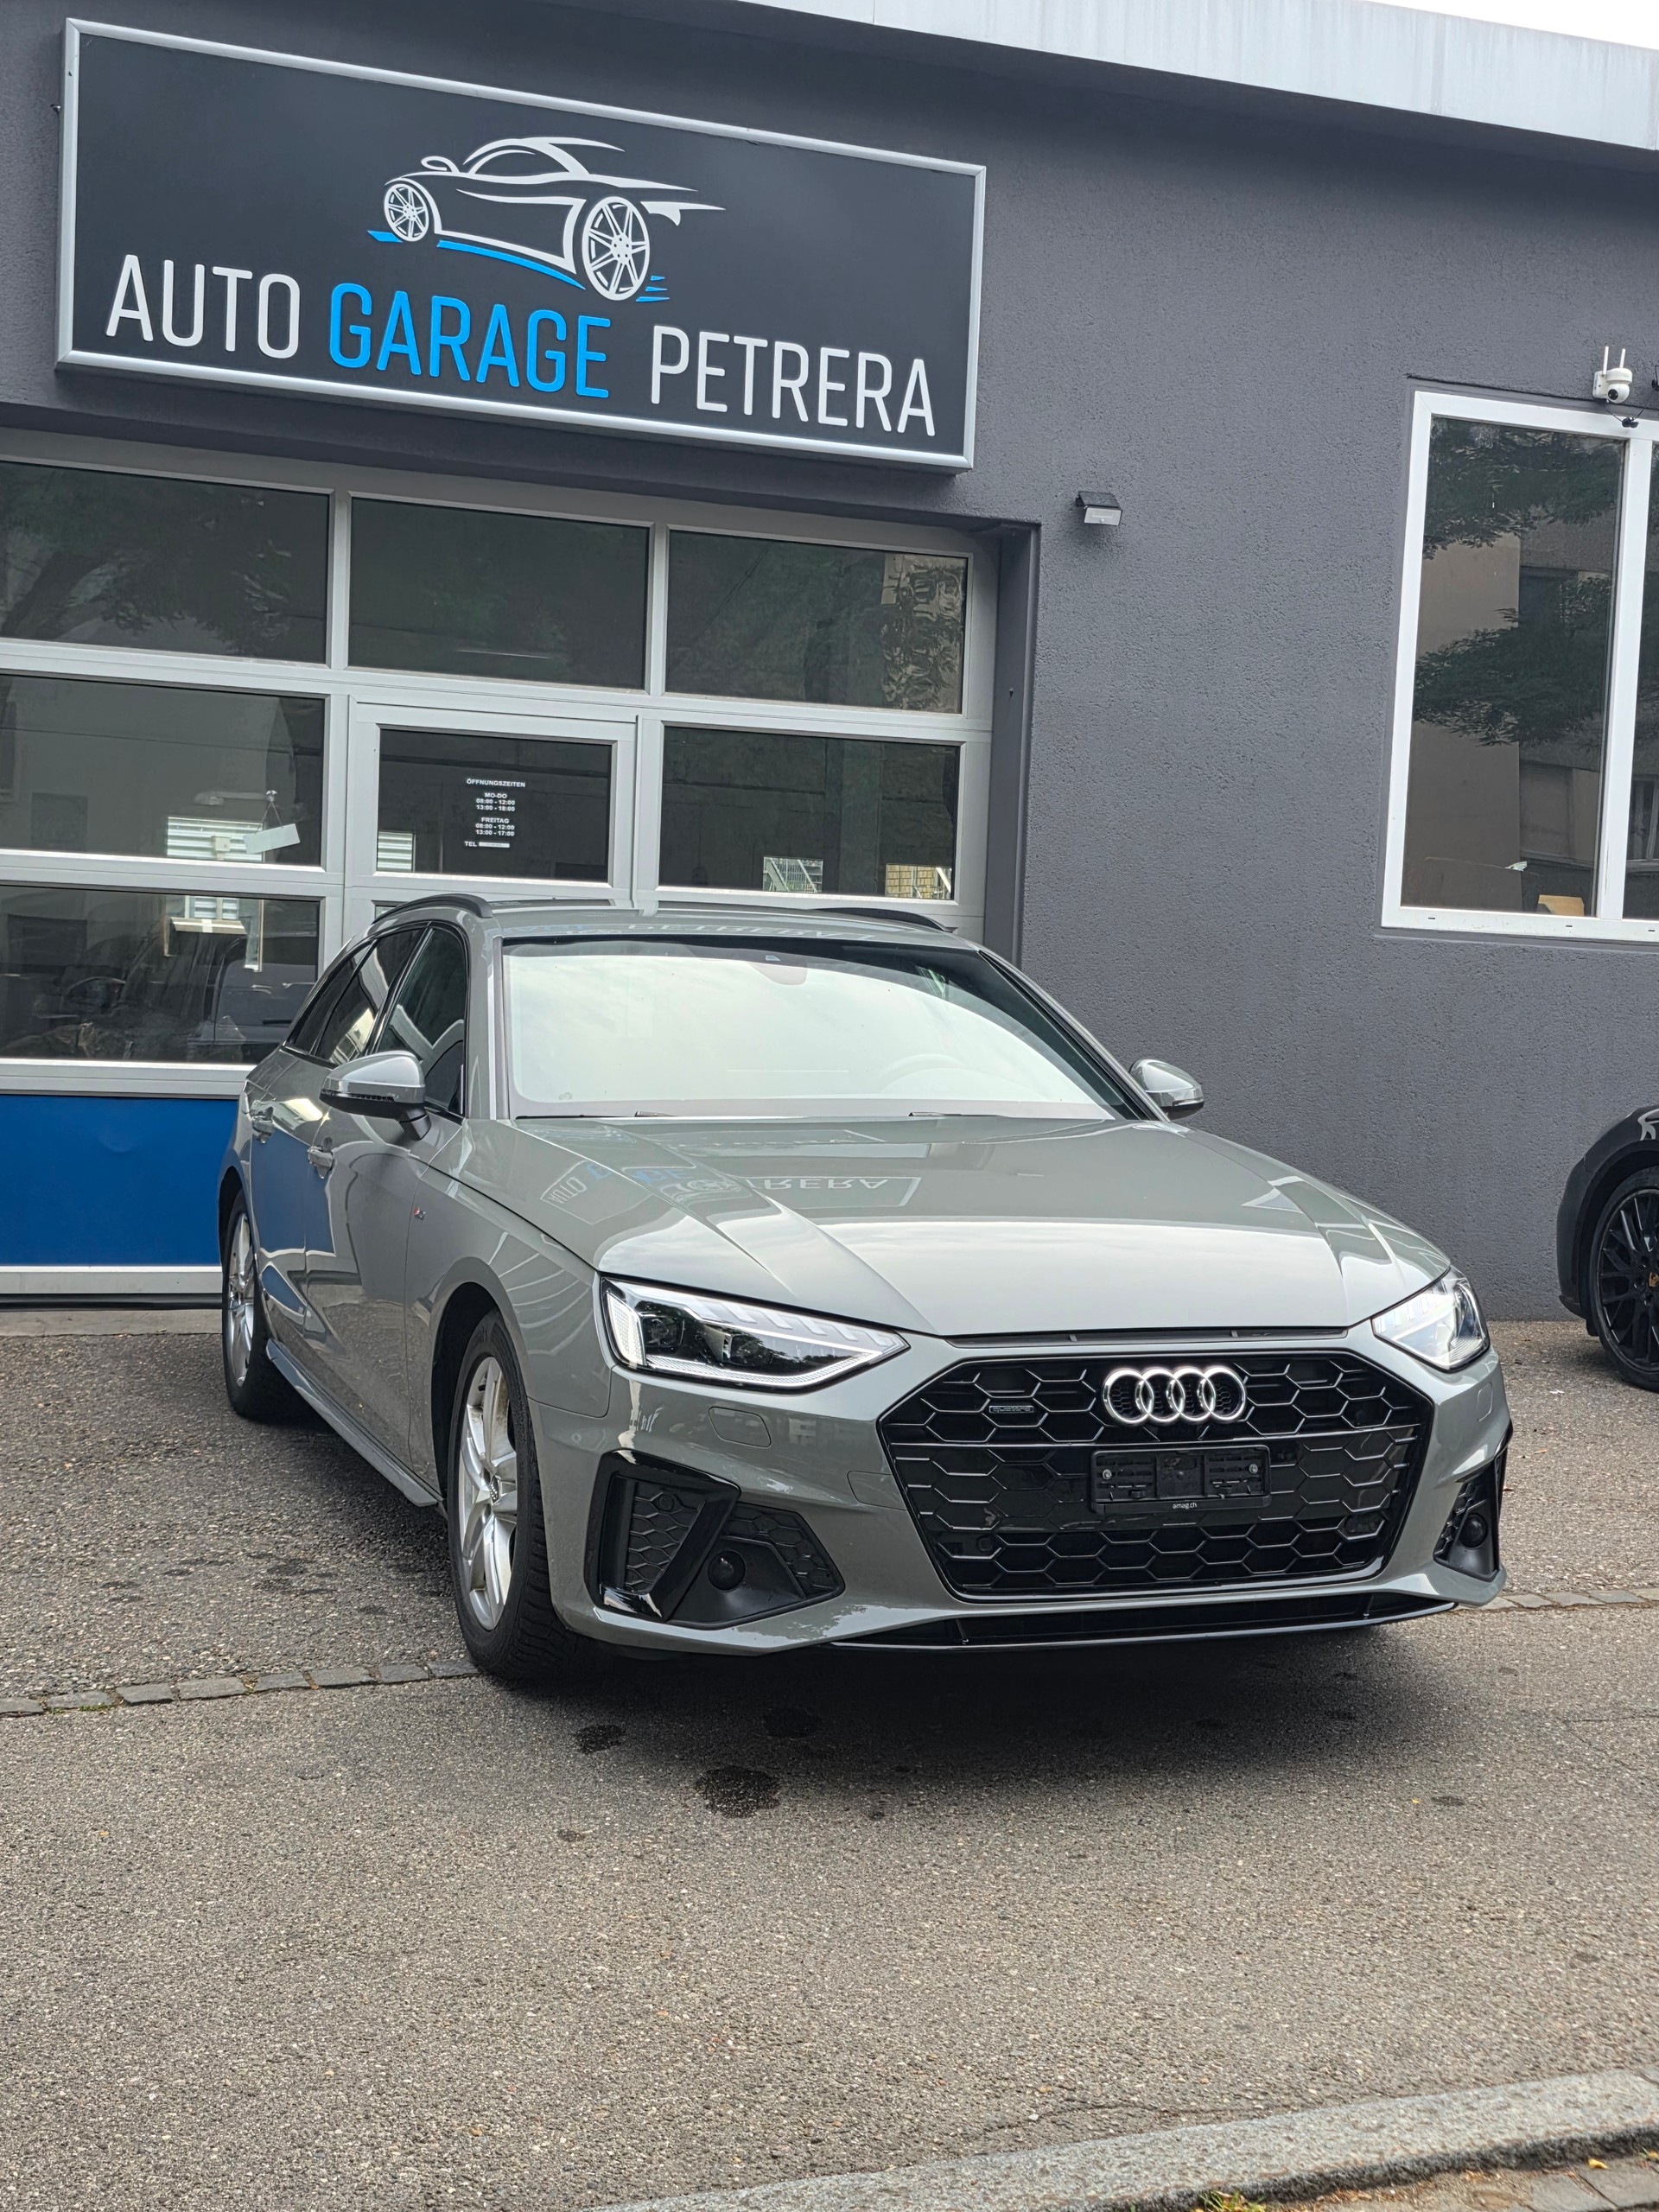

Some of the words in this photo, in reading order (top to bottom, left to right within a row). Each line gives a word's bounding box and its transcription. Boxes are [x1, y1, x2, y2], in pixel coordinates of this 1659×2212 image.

[105, 254, 301, 359] AUTO
[329, 283, 611, 399] GARAGE
[651, 325, 936, 437] PETRERA
[467, 779, 526, 787] ÖFFNUNGSZEITEN
[1172, 1501, 1198, 1510] amag.ch
